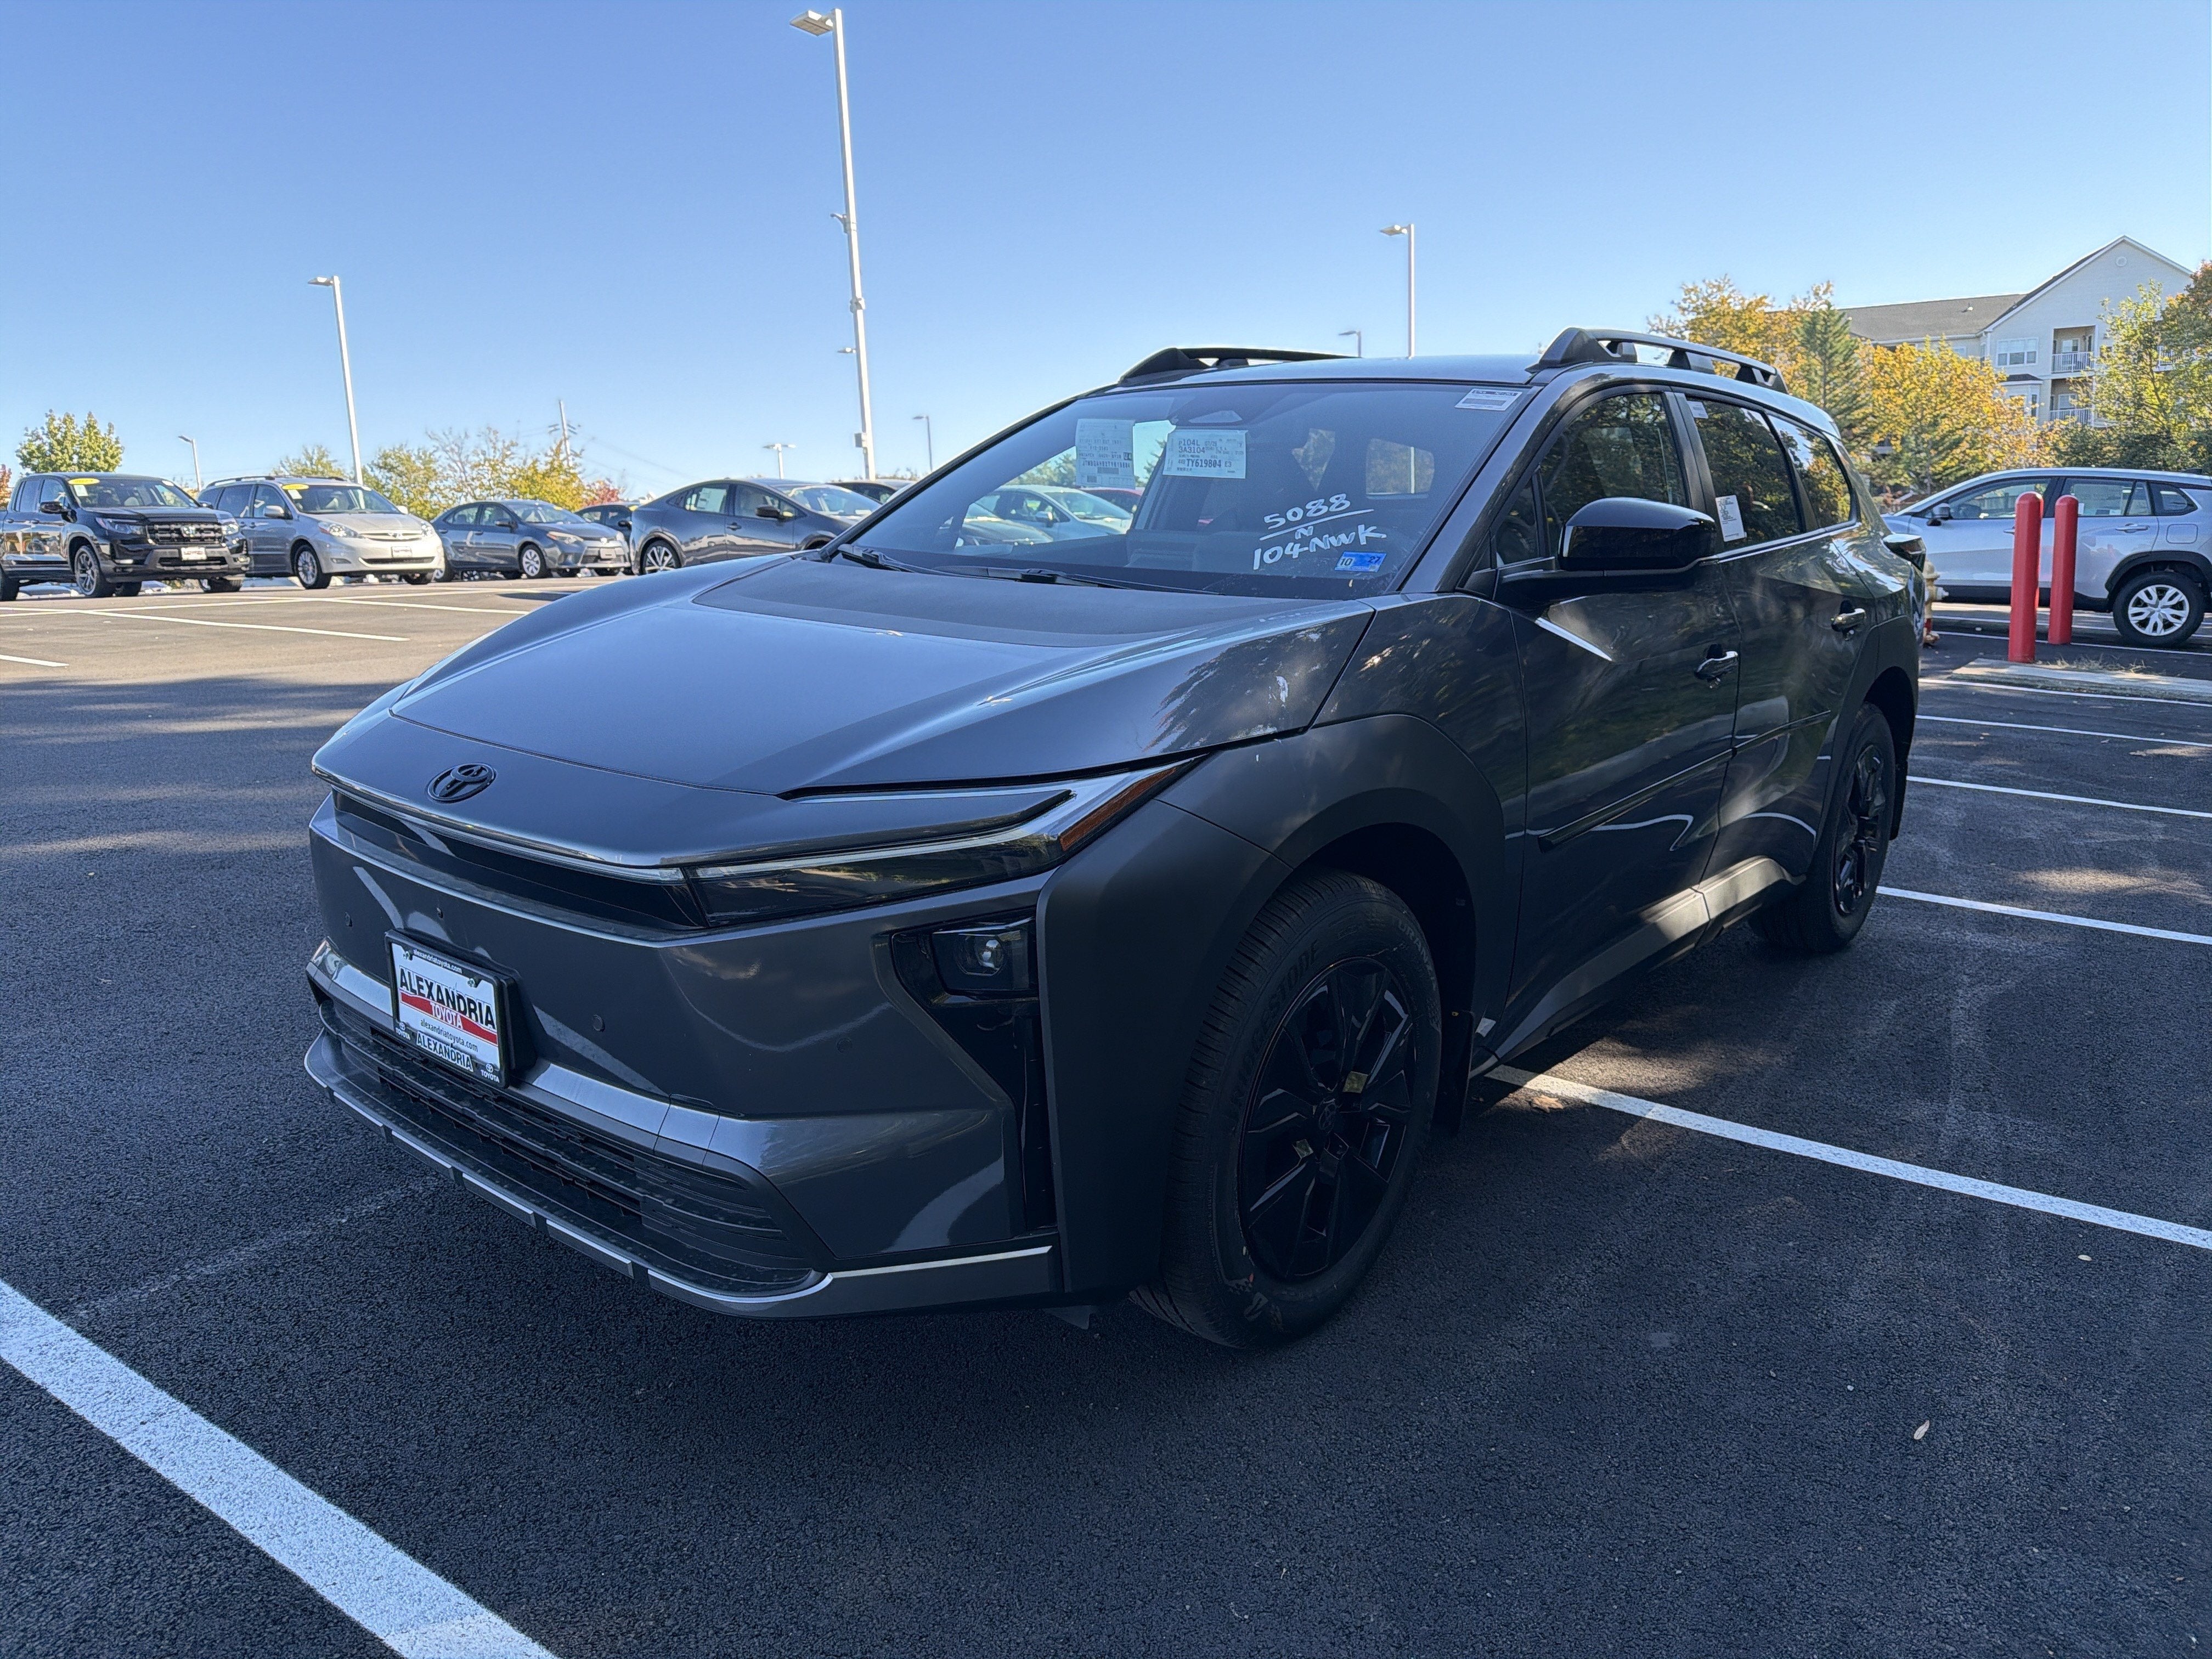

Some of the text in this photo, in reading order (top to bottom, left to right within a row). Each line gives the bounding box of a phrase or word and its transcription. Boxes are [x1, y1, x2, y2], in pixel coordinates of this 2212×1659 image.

[1186, 458, 1222, 468] TY619804
[1263, 493, 1351, 530] 5088
[1340, 556, 1381, 566] 10 27
[400, 966, 496, 1030] ALEXANDRIA
[430, 1002, 464, 1030] TOYOTA
[395, 1029, 410, 1041] TOYOTA
[420, 1018, 478, 1053] alexandriatoyota.com
[416, 1031, 473, 1073] ALEXANDRIA
[481, 1069, 500, 1084] TOYOTA
